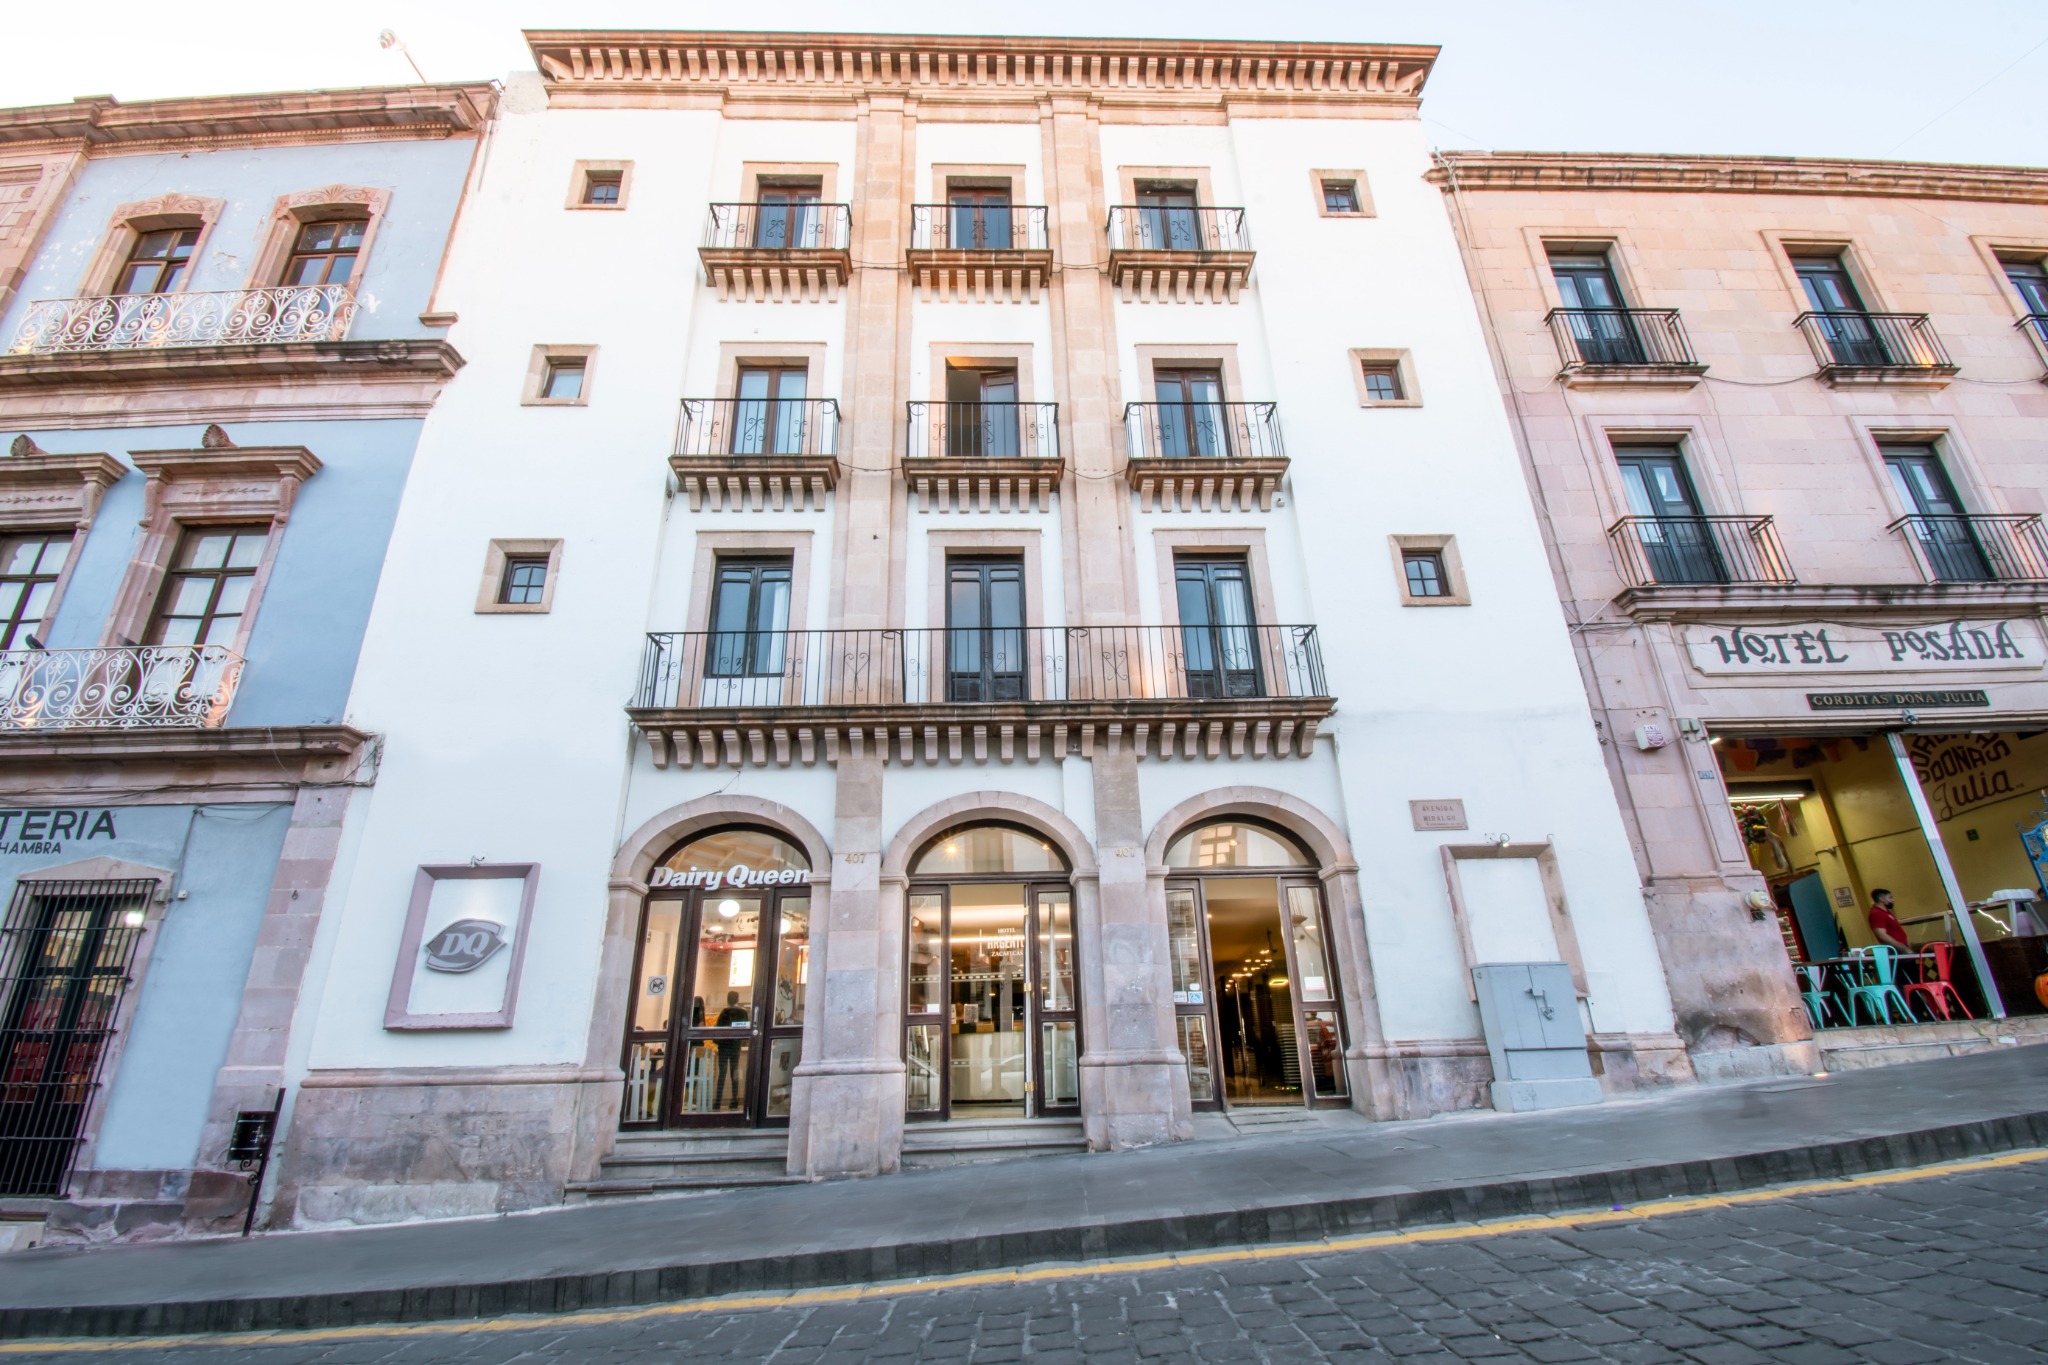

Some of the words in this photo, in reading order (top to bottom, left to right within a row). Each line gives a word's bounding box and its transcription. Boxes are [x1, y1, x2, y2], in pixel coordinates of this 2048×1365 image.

[1711, 627, 1848, 664] HOTEL
[1881, 621, 2024, 662] POSADA
[1813, 694, 1889, 706] GORDITAS
[1895, 692, 1936, 704] DOÑA
[1943, 692, 1986, 703] JULIA
[1930, 745, 1987, 782] DOÑA
[1932, 769, 2015, 821] Julia
[0, 810, 117, 841] TERIA
[844, 852, 866, 865] 407
[649, 865, 723, 891] Dairy
[726, 864, 811, 888] Queen
[438, 931, 490, 958] DQ
